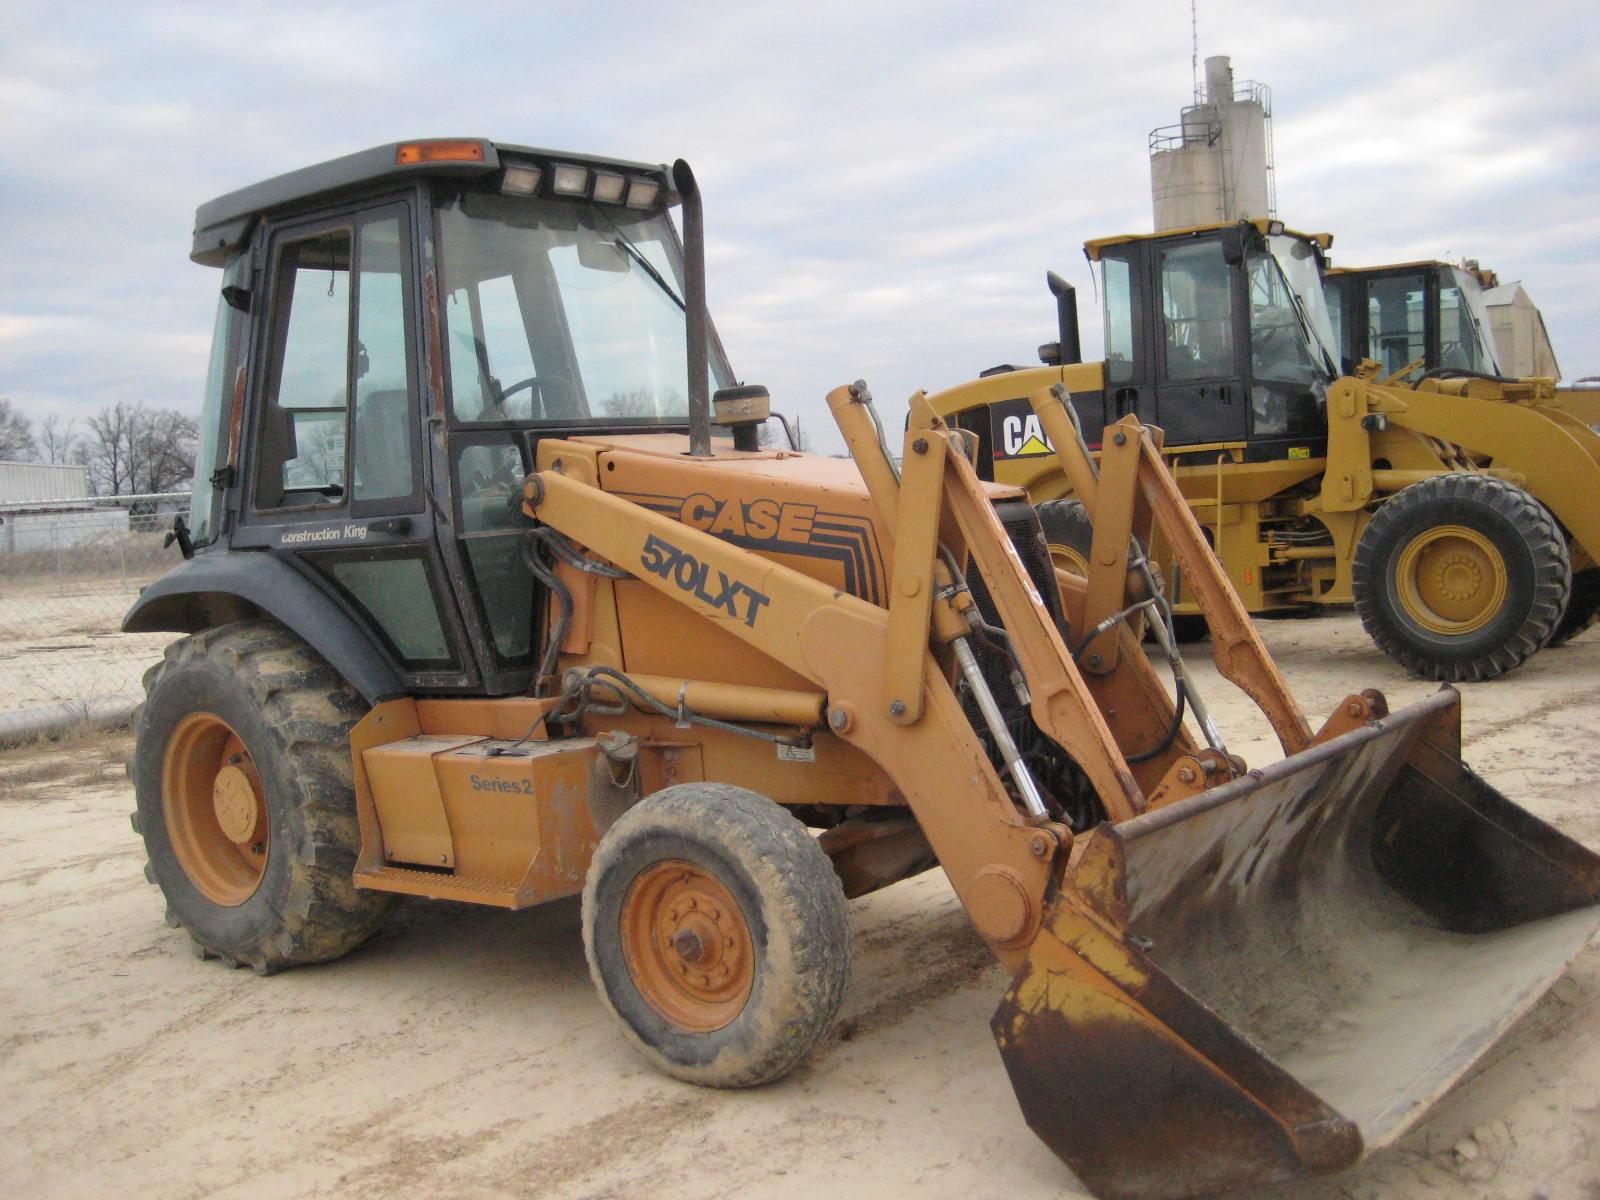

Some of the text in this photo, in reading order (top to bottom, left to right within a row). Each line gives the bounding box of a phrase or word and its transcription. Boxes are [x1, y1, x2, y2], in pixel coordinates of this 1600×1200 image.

[1003, 414, 1055, 456] CA
[344, 525, 367, 539] King
[680, 493, 817, 545] CASE
[641, 534, 770, 628] 570LXT
